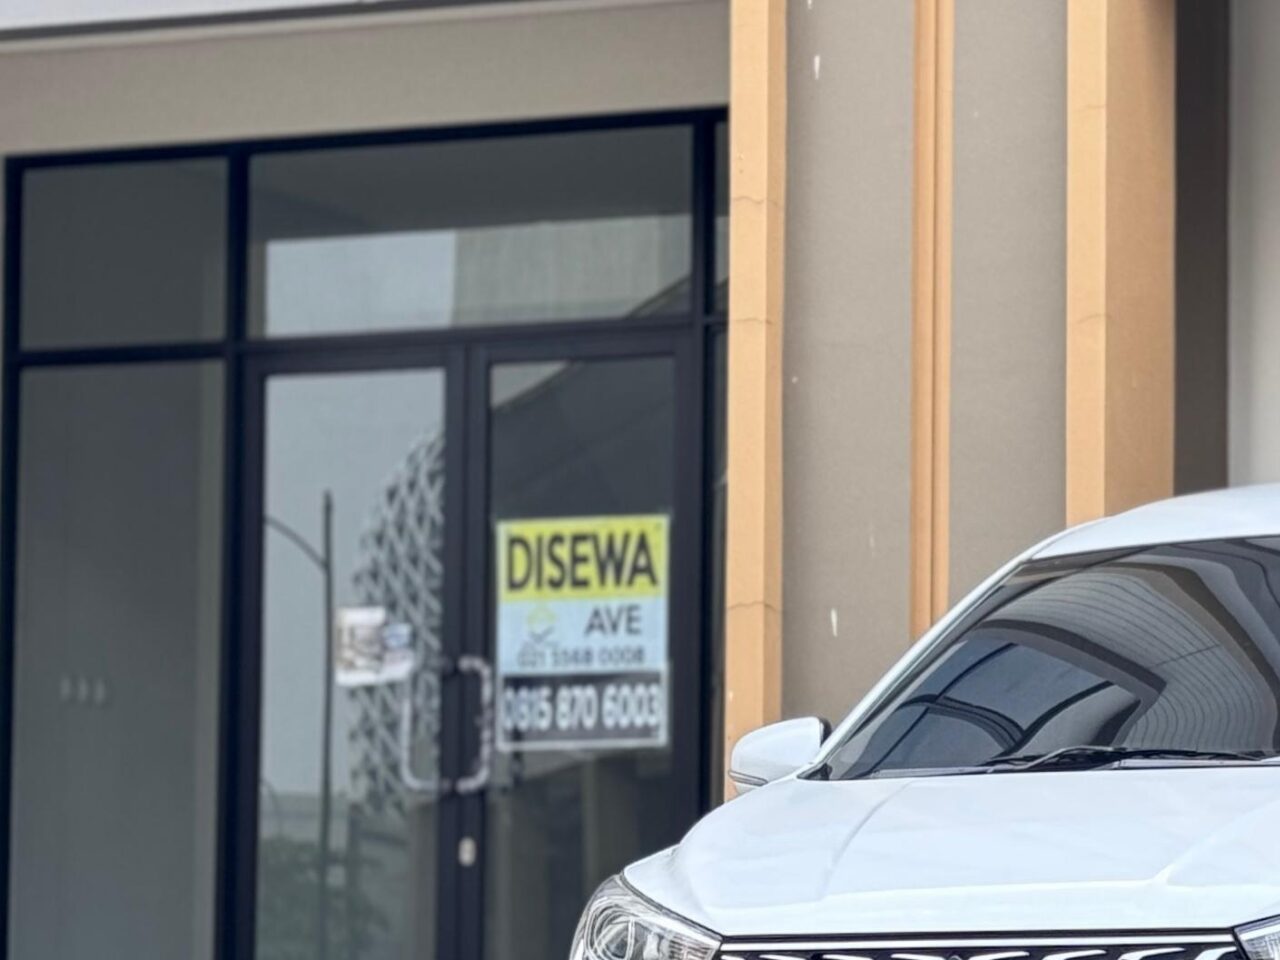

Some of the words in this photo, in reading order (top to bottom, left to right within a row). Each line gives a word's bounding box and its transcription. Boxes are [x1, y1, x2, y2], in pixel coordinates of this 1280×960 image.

[507, 531, 658, 591] DISEWA
[584, 605, 643, 635] AVE
[556, 684, 598, 731] 870
[602, 683, 660, 729] 6003
